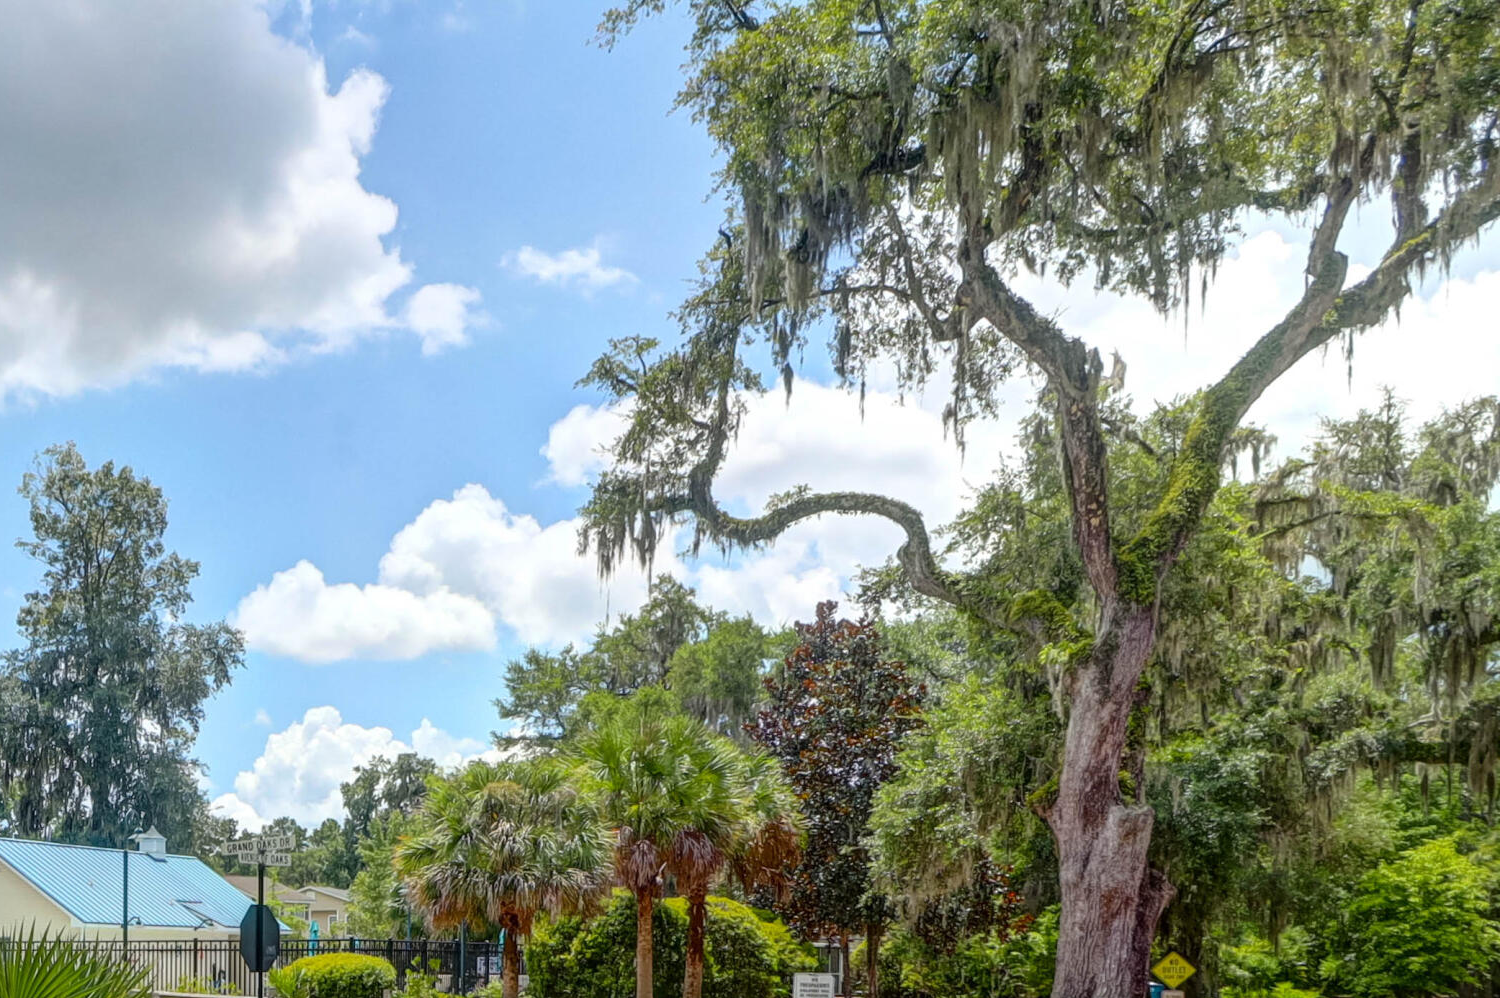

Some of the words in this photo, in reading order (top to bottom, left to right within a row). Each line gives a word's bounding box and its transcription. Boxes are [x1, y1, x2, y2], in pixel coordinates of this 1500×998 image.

[226, 842, 254, 853] GRAND
[256, 839, 277, 849] OAKS
[280, 837, 290, 847] DR
[270, 854, 289, 864] OAKS
